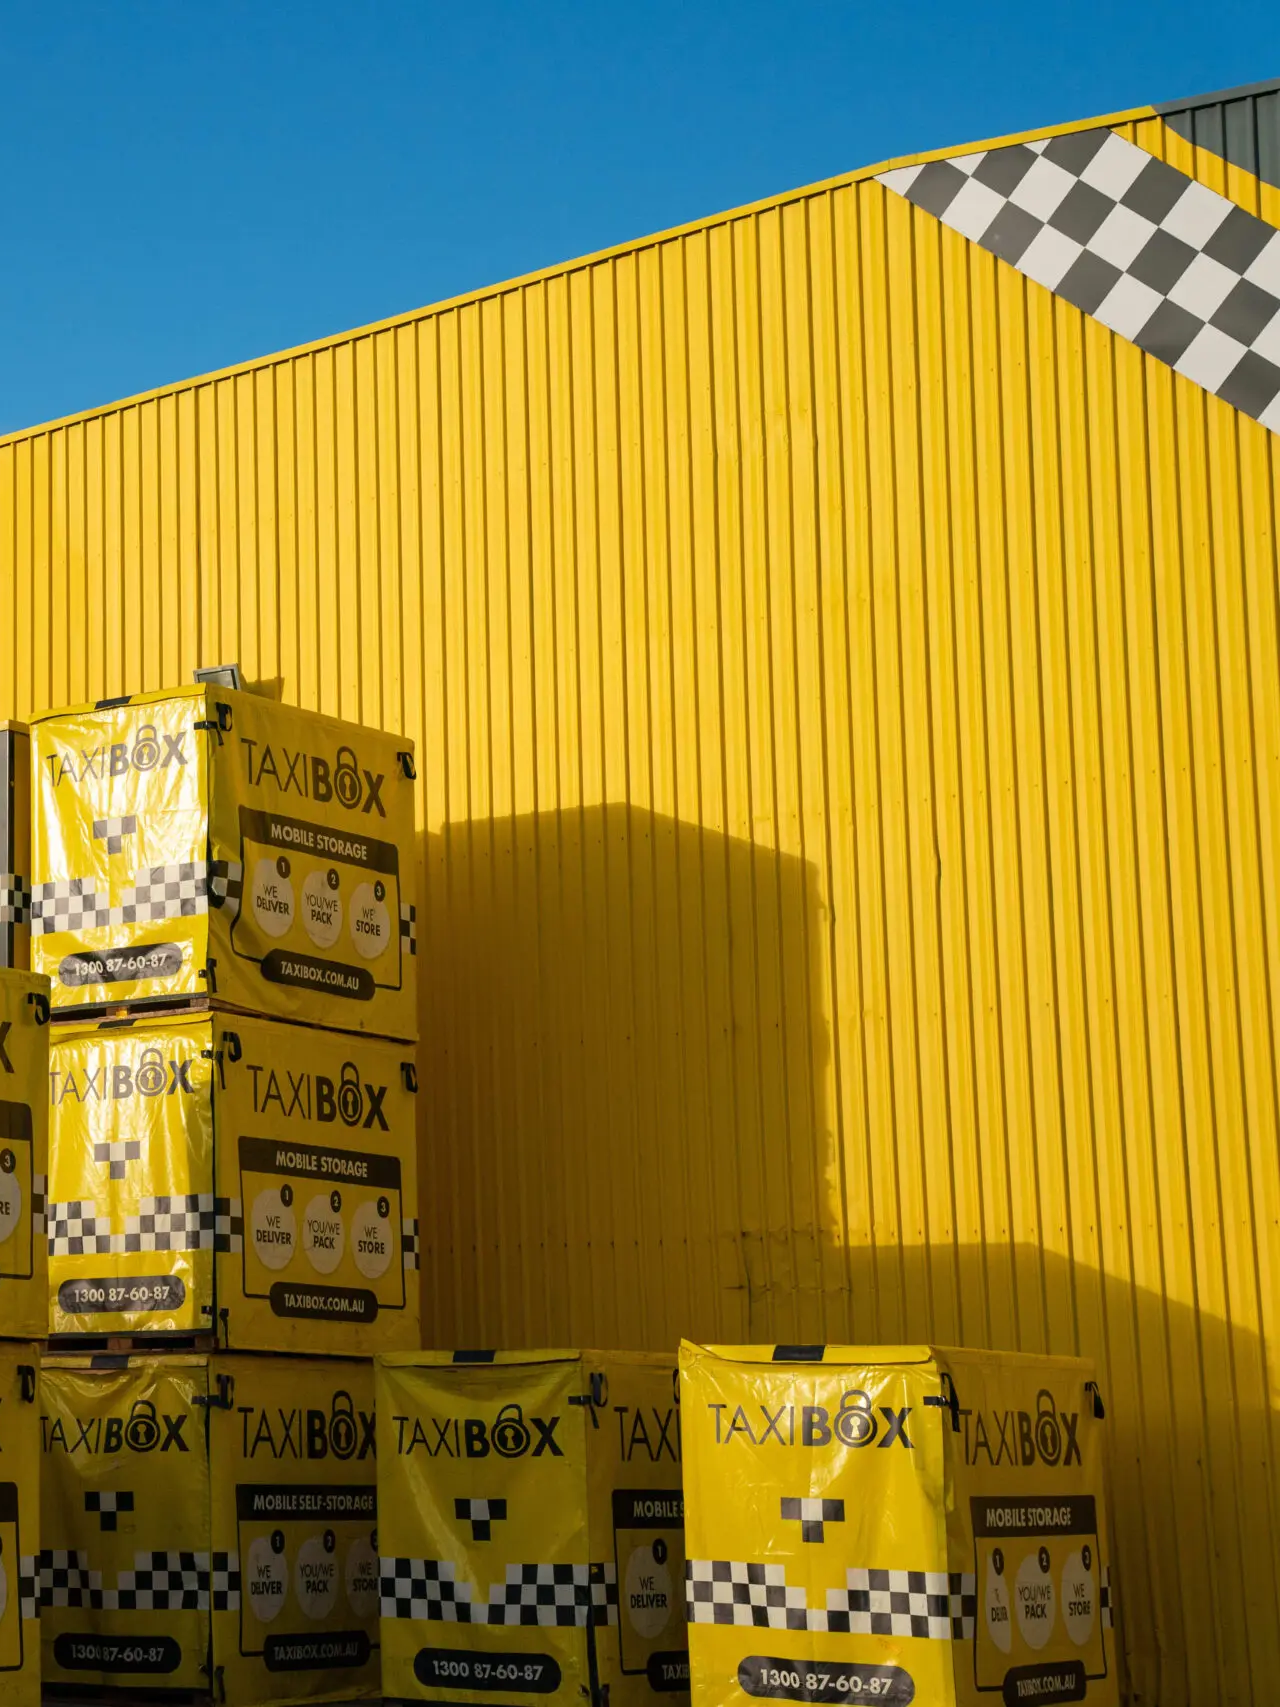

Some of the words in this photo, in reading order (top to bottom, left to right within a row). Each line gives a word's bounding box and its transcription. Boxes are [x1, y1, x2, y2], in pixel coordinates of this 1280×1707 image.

[46, 724, 188, 787] TAXIBOX
[241, 737, 386, 818] TAXIBOX
[272, 824, 314, 847] MOBILE
[317, 834, 367, 860] STORAGE
[281, 862, 286, 873] 1
[330, 874, 336, 885] 2
[263, 884, 278, 898] WE
[376, 886, 382, 897] 3
[256, 895, 289, 915] DELIVER
[305, 893, 338, 912] YOU/WE
[311, 909, 332, 925] PACK
[362, 908, 375, 920] WE
[356, 920, 381, 936] STORE
[75, 959, 103, 975] 1300
[106, 954, 167, 972] 87-60-87
[281, 961, 359, 991] TAXIBOX.COM.AU
[50, 1047, 195, 1105] TAXIBOX
[246, 1061, 389, 1131] TAXIBOX
[4, 1154, 11, 1167] 3
[276, 1151, 318, 1171] MOBILE
[321, 1159, 368, 1178] STORAGE
[285, 1190, 289, 1200] 1
[333, 1196, 339, 1207] 2
[380, 1202, 386, 1213] 3
[266, 1216, 280, 1229] WE
[308, 1220, 340, 1235] YOU/WE
[256, 1229, 291, 1244] DELIVER
[364, 1227, 378, 1239] WE
[313, 1236, 335, 1249] PACK
[358, 1239, 385, 1254] STORE
[74, 1289, 105, 1302] 1300
[109, 1286, 170, 1301] 87-60-87
[284, 1293, 364, 1313] TAXIBOX.COM.AU
[708, 1389, 915, 1448] TAXIBOX
[40, 1400, 189, 1454] TAXIBOX
[392, 1404, 564, 1458] TAXIBOX
[959, 1389, 1082, 1467] TAXIBOX
[253, 1494, 298, 1510] MOBILE
[633, 1500, 678, 1518] MOBILE
[987, 1508, 1026, 1527] MOBILE
[1027, 1507, 1071, 1526] STORAGE
[257, 1564, 271, 1578] WE
[300, 1564, 334, 1577] YOU/WE
[359, 1563, 372, 1575] WE
[251, 1580, 282, 1595] DELIVER
[306, 1580, 329, 1593] PACK
[639, 1577, 654, 1590] WE
[1073, 1583, 1085, 1597] WE
[630, 1593, 667, 1608] DELIVER
[1019, 1586, 1051, 1600] YOU/WE
[1025, 1603, 1047, 1619] PACK
[1069, 1600, 1090, 1615] STORE
[103, 1646, 164, 1662] 87-60-87
[274, 1641, 358, 1660] TAXIBOX.COM.AU
[432, 1660, 469, 1677] 1300
[474, 1663, 544, 1681] 87-60-87
[760, 1669, 800, 1687] 1300
[806, 1674, 893, 1694] 87-60-87
